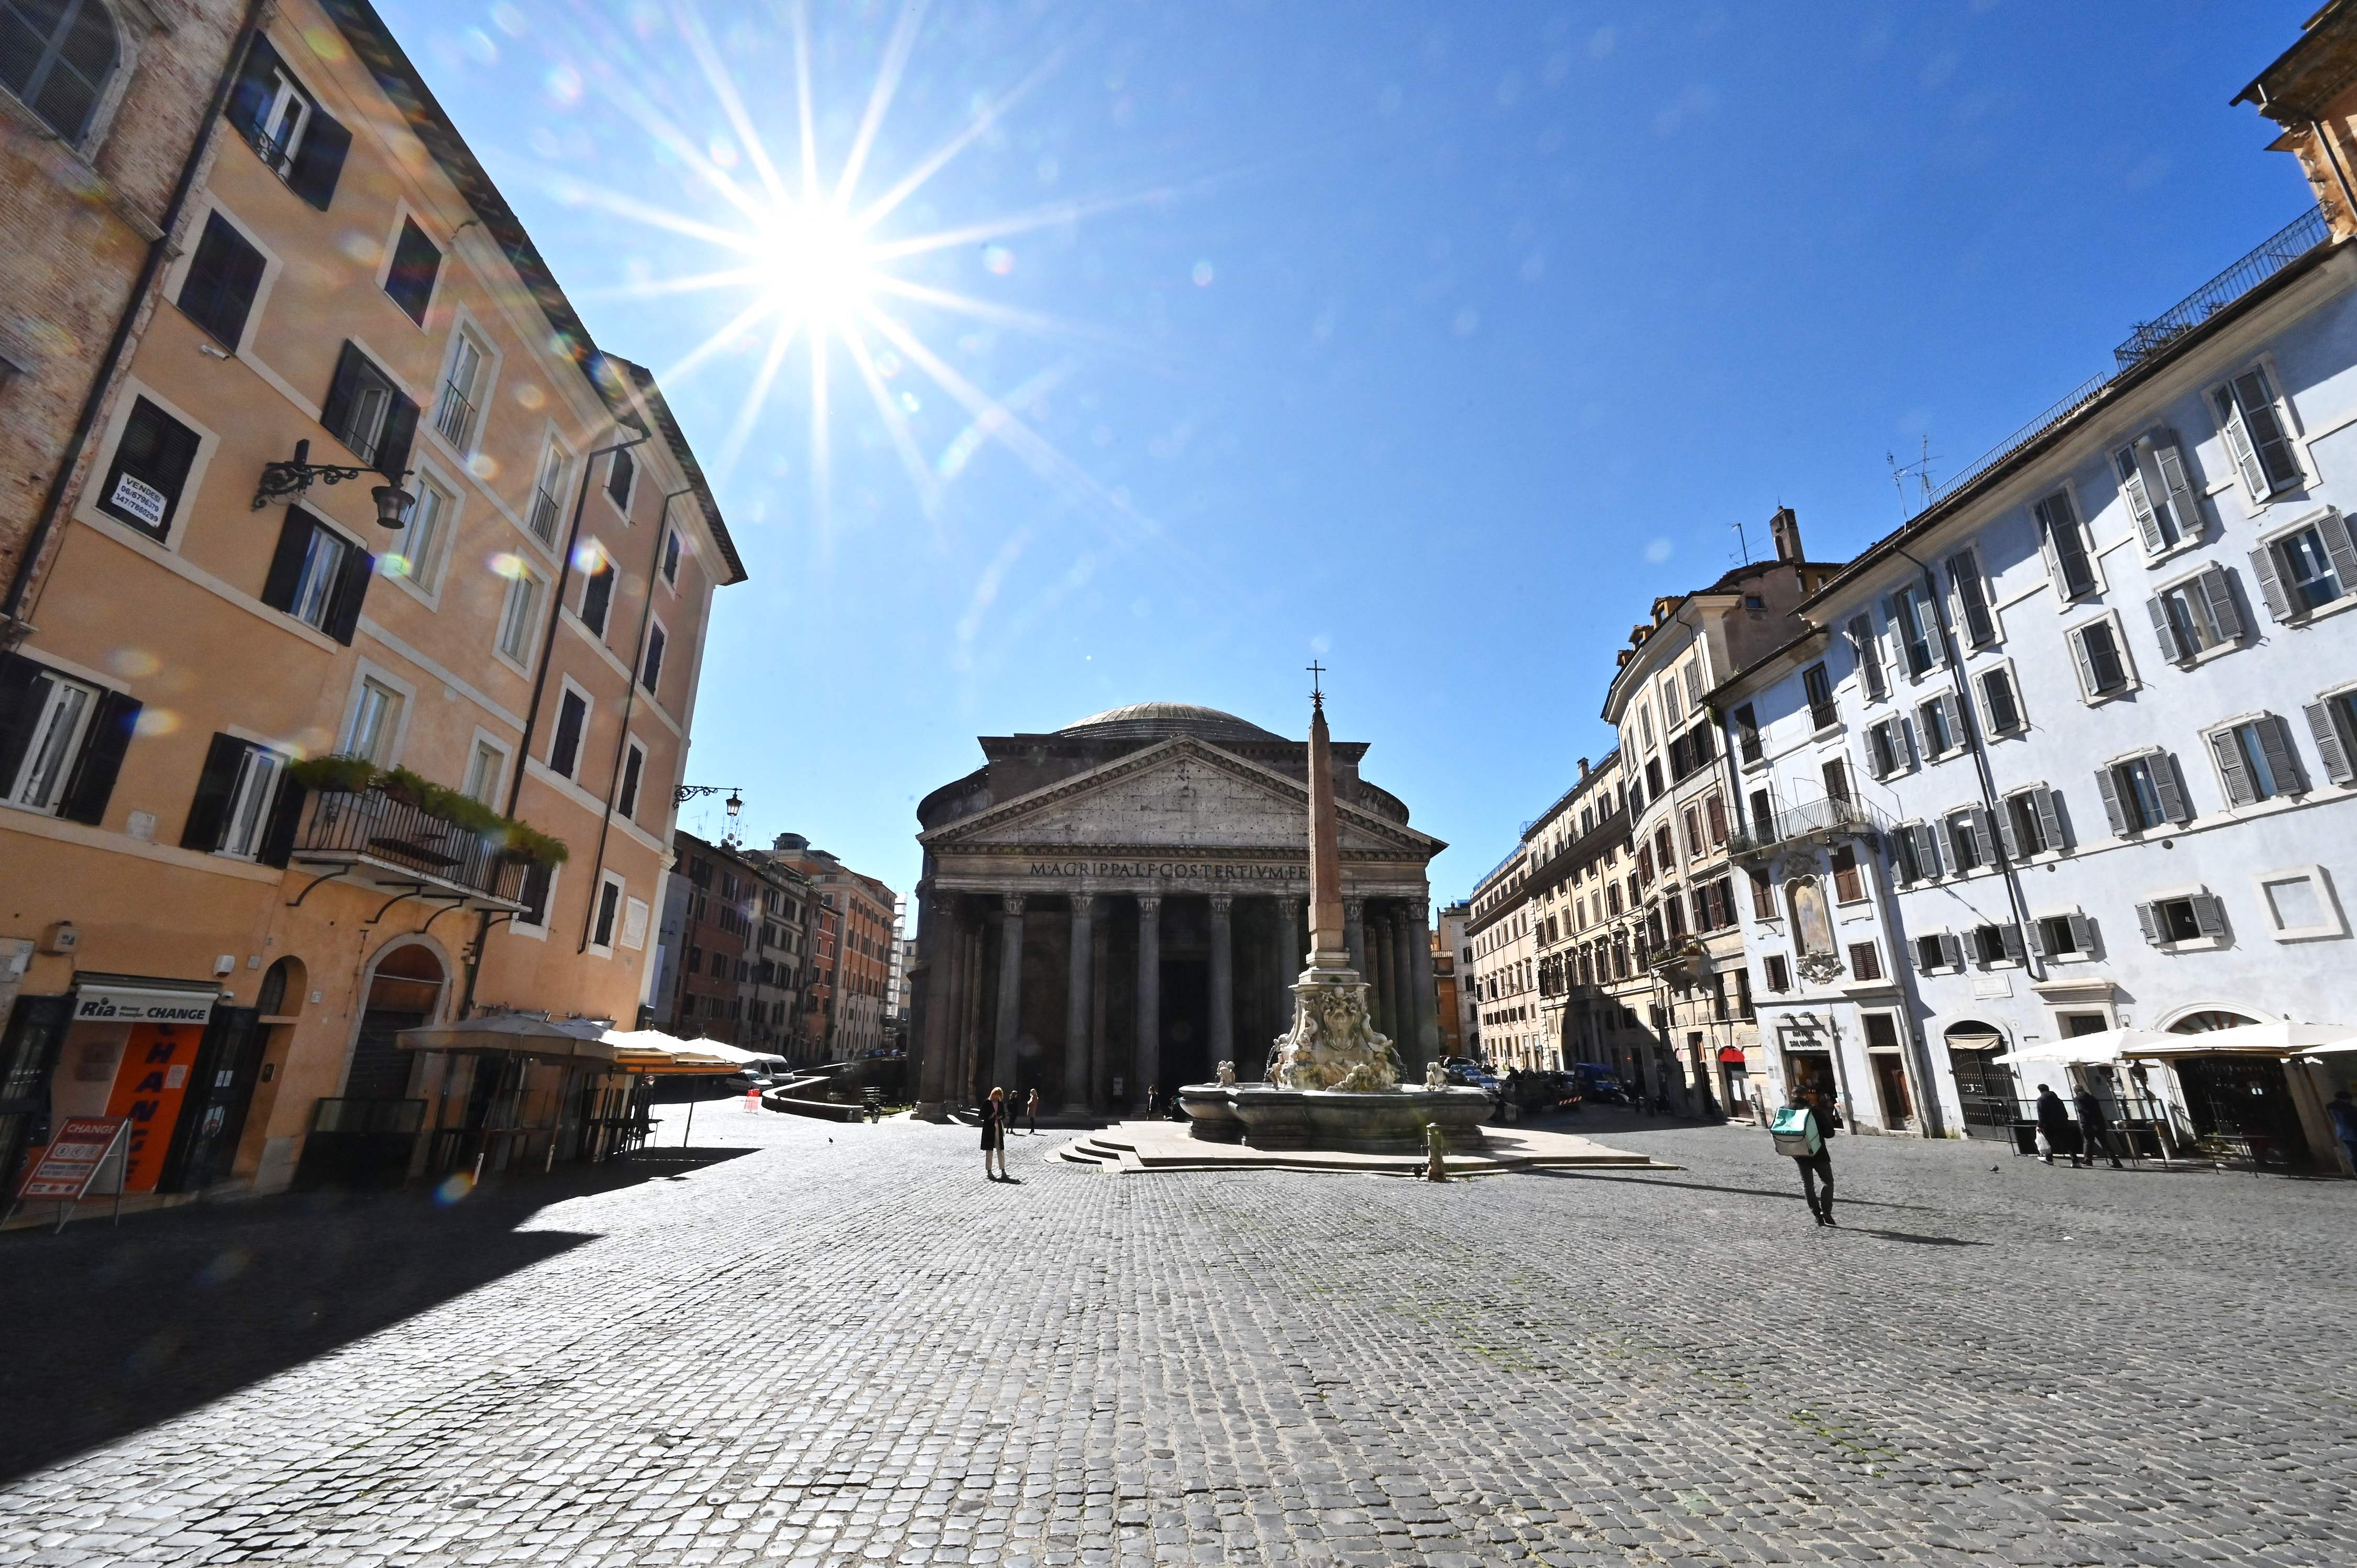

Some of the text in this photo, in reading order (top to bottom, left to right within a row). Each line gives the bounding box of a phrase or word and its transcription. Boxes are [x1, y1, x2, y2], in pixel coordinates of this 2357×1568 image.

[126, 478, 160, 502] VENDESI
[80, 997, 206, 1020] Ria CHANGE
[67, 1123, 117, 1134] CHANGE
